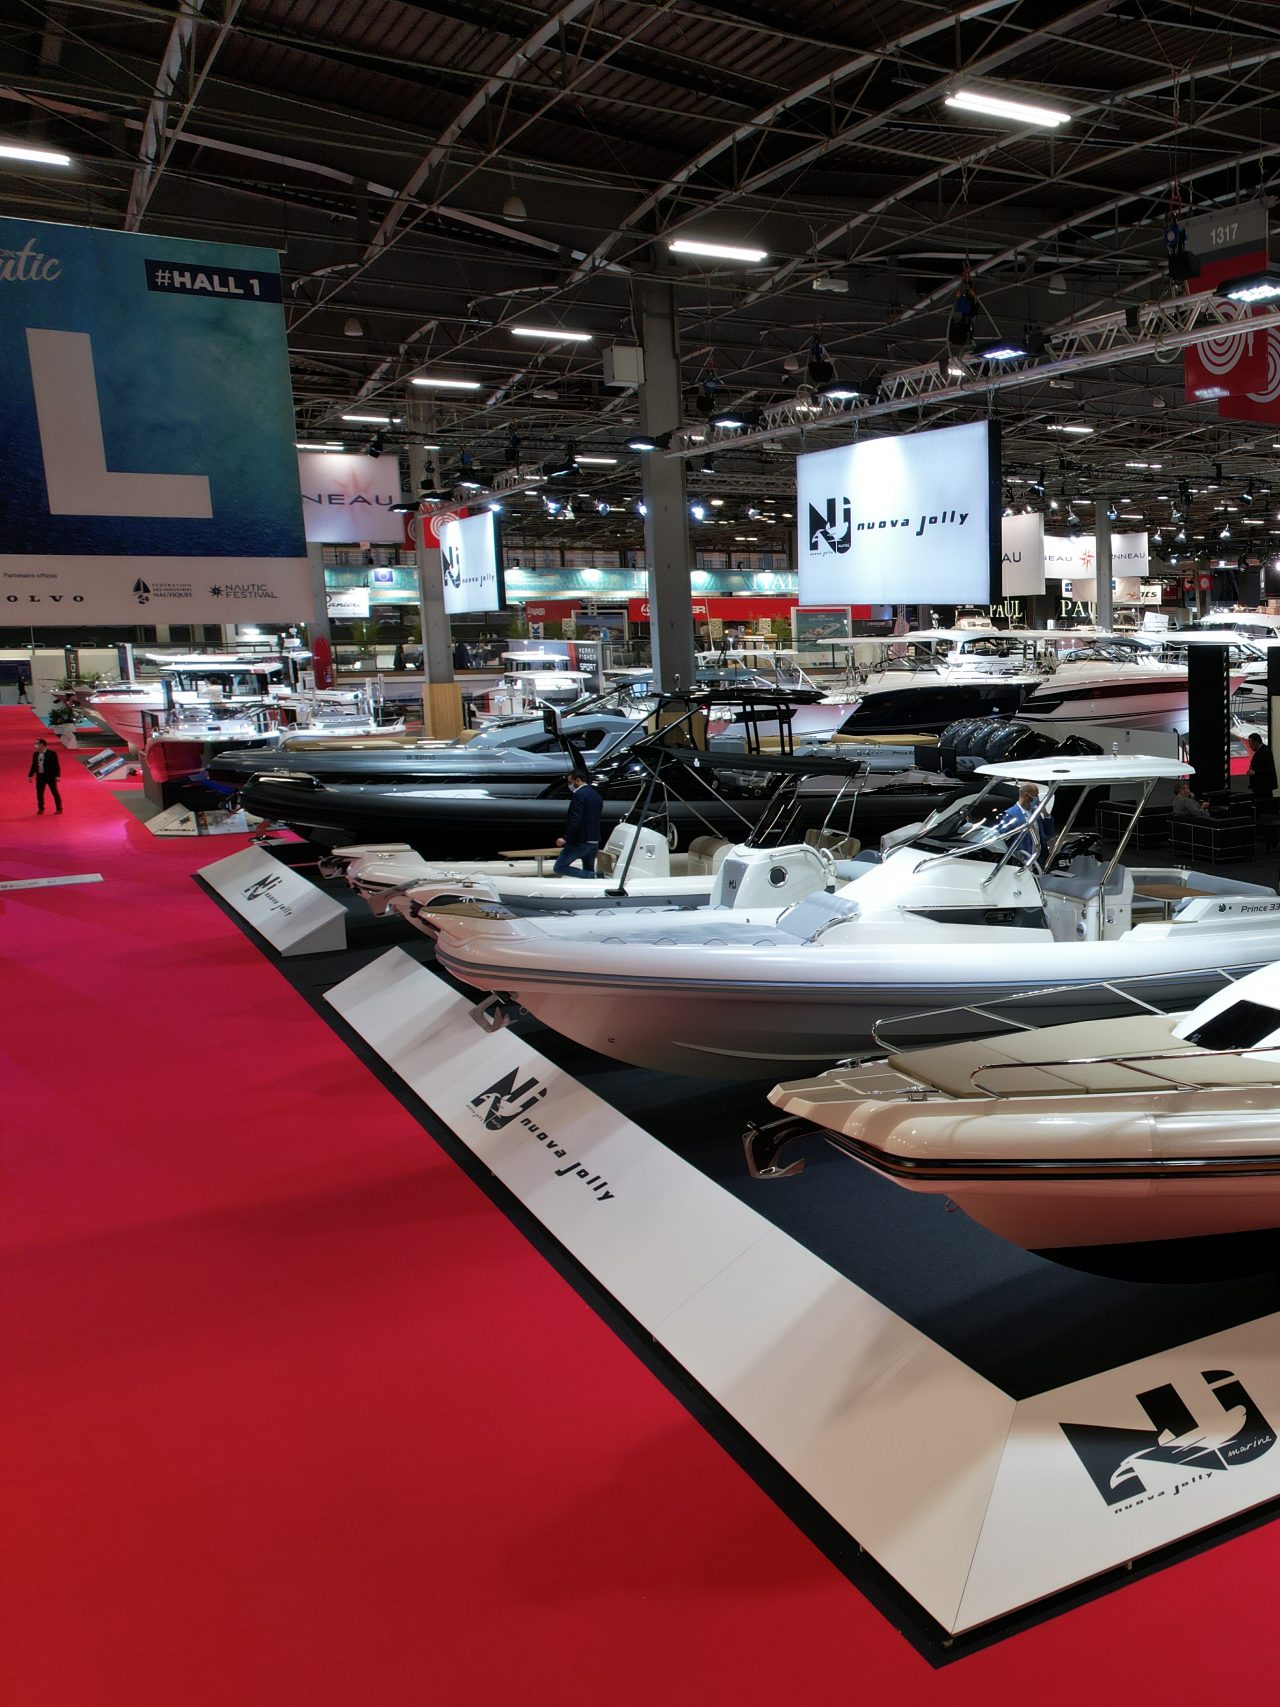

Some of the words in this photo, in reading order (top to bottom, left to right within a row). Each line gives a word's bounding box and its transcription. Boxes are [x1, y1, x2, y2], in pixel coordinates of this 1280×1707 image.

[1210, 223, 1238, 245] 1317
[154, 268, 244, 295] #HALL
[249, 277, 260, 296] 1
[26, 327, 214, 519] L
[856, 517, 910, 531] nuova
[153, 591, 193, 599] NAUTIQUES
[225, 583, 268, 592] NAUTIC
[225, 590, 278, 599] FESTIVAL
[579, 662, 597, 671] SPORT
[1240, 904, 1268, 913] Prince
[1269, 902, 1280, 911] 33
[520, 1117, 567, 1159] nuova
[1227, 1434, 1273, 1458] marine
[1114, 1489, 1166, 1515] nuova
